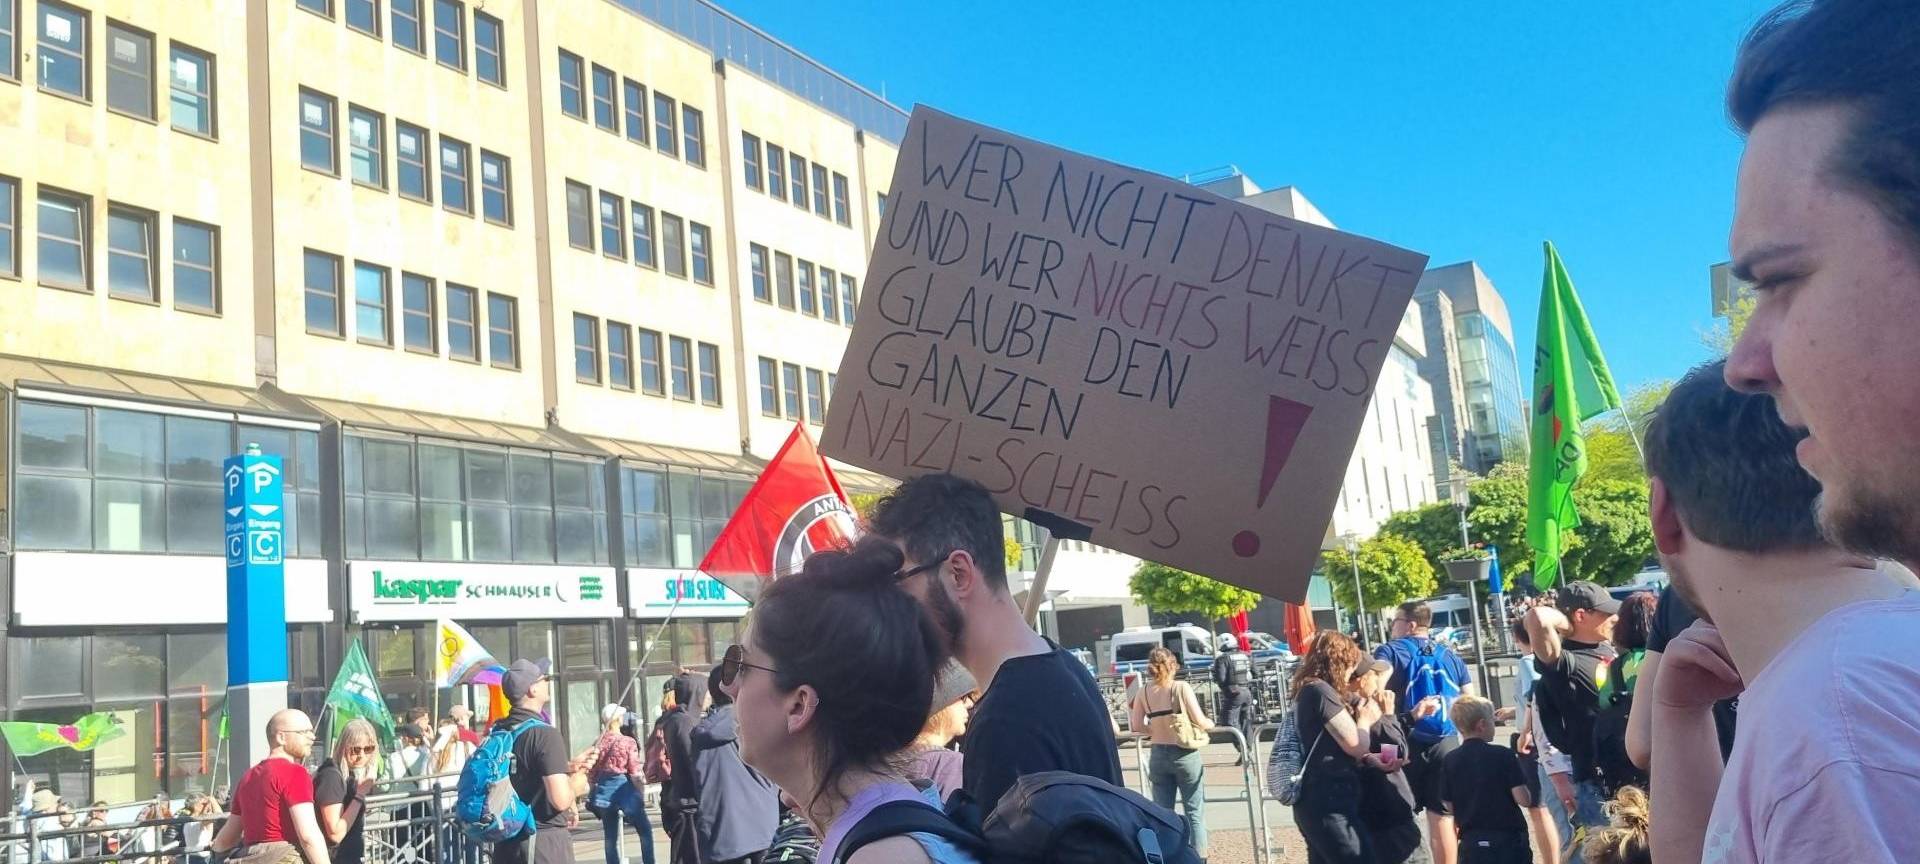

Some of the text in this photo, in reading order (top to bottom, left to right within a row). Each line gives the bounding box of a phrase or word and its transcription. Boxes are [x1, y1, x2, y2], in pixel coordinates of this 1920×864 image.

[888, 191, 969, 266] UND
[981, 222, 1064, 299] WER
[1073, 252, 1227, 350] NICHTS
[923, 120, 1412, 329] WER NICHT DENKT
[867, 331, 1084, 440] GANZEN
[878, 266, 1190, 408] GLAUBT DEN
[229, 473, 240, 496] P
[254, 471, 273, 494] P
[842, 390, 1187, 549] NAZI-SCHEISS
[1231, 394, 1314, 559] !
[231, 536, 241, 557] C
[256, 533, 274, 556] C
[373, 570, 463, 605] kaspar
